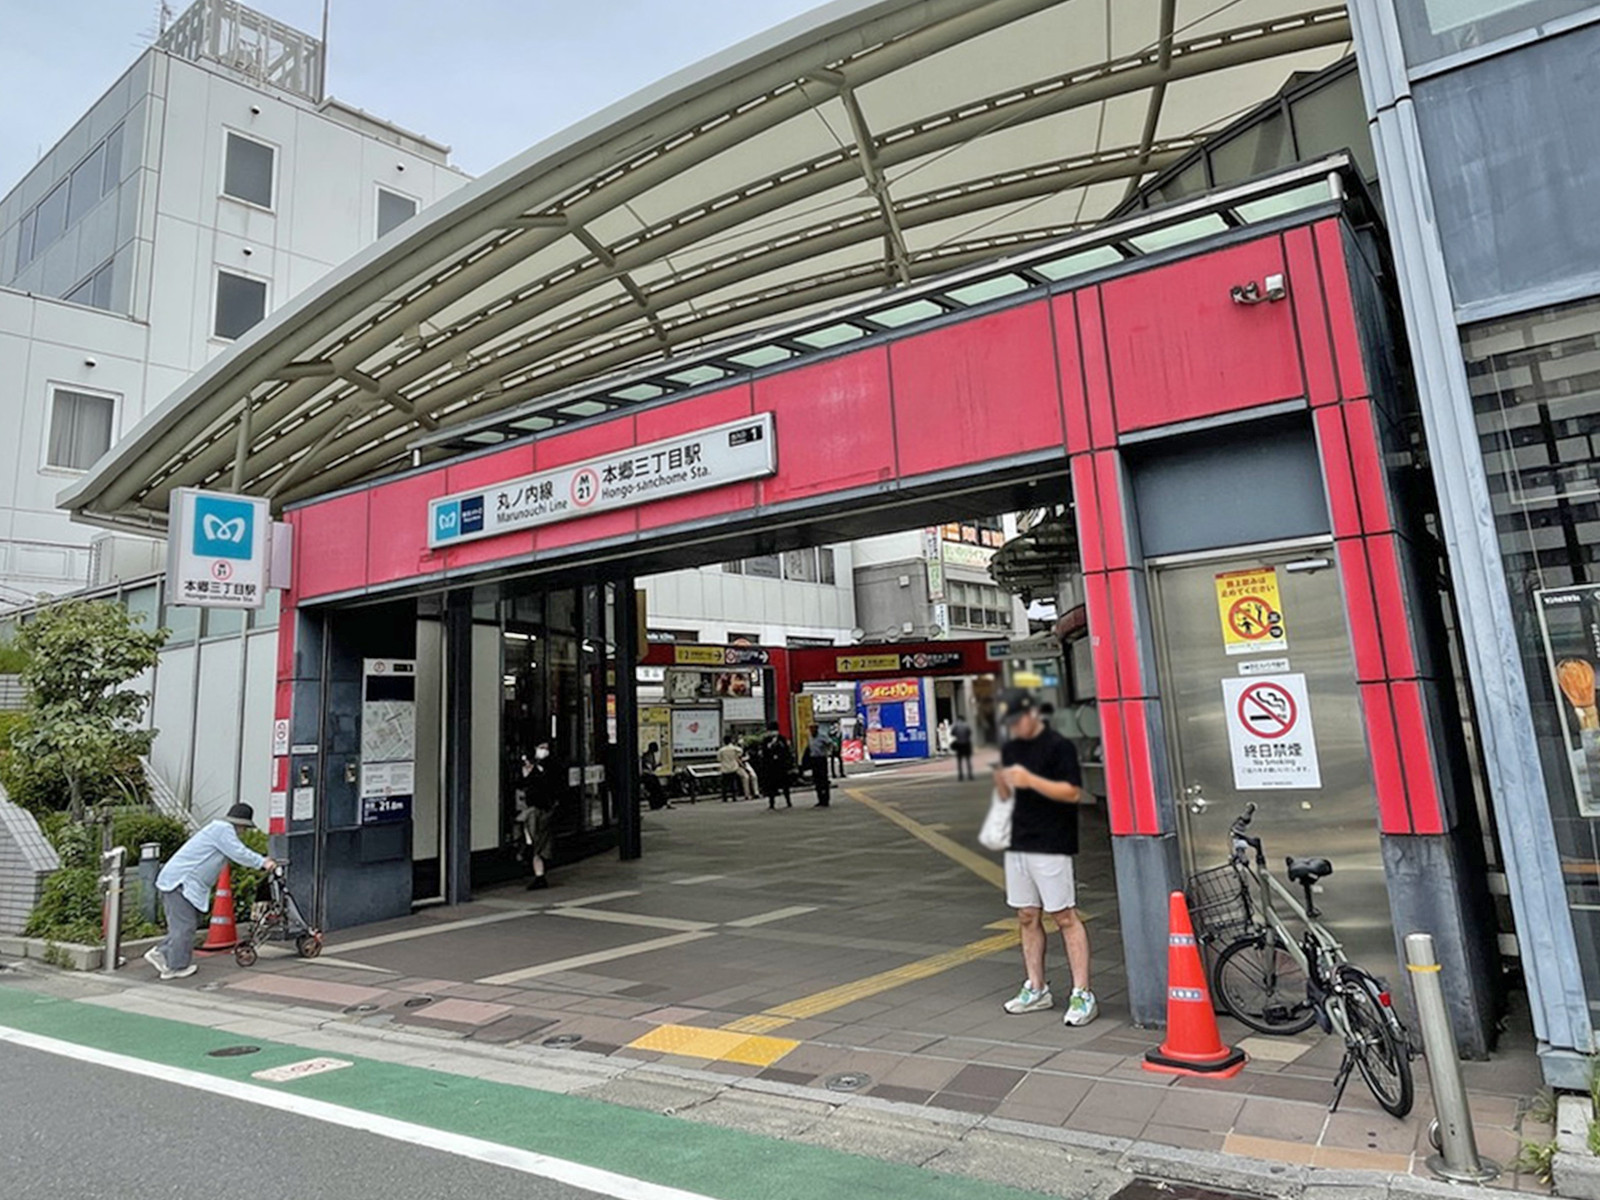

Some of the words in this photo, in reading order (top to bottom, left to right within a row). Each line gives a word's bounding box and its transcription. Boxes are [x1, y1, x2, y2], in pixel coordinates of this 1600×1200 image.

[750, 427, 758, 440] 1
[602, 443, 702, 484] 本郷三丁目駅
[579, 475, 590, 485] M
[602, 473, 687, 500] Hongo-sanchome
[690, 466, 712, 480] Sta.
[497, 480, 554, 511] 丸ノ内線
[577, 486, 590, 500] 21
[497, 501, 547, 524] Marunouchi
[548, 497, 569, 513] Line
[184, 580, 256, 597] 本郷三丁目駅
[860, 659, 866, 668] 2
[1243, 743, 1303, 758] 終日禁煙
[1265, 758, 1297, 767] Smoking
